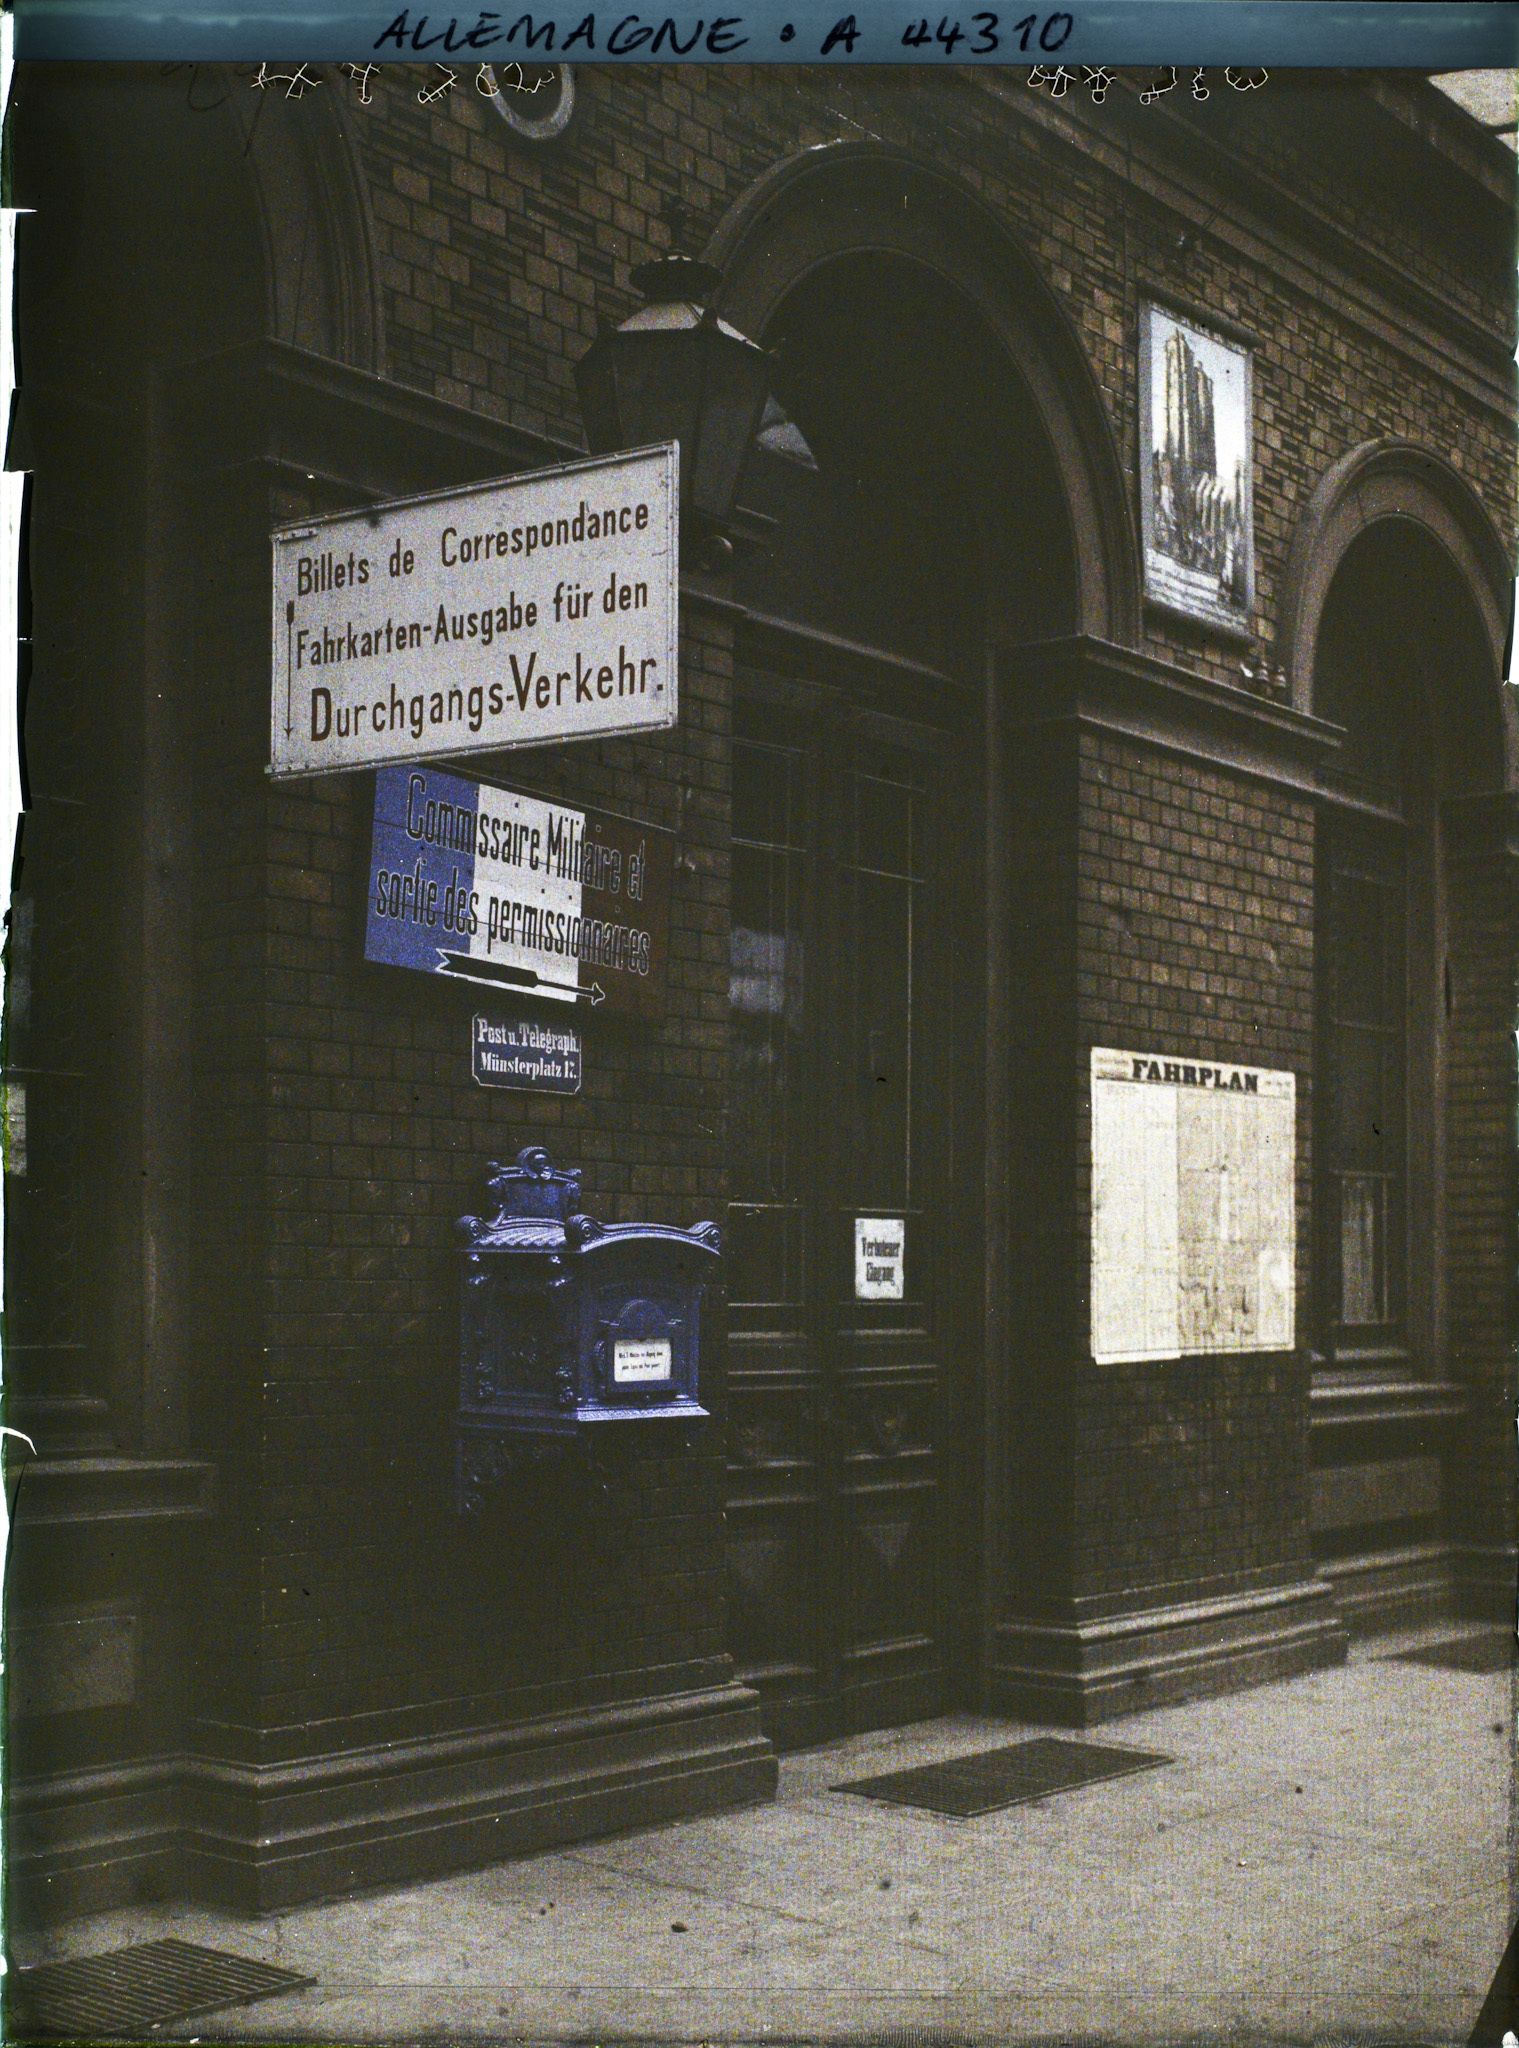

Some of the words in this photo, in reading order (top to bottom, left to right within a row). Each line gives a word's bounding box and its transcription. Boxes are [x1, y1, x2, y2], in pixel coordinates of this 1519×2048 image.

[821, 15, 861, 55] A
[297, 552, 370, 597] Billets
[388, 538, 415, 578] de
[441, 501, 649, 567] Correspondance
[297, 591, 538, 669] Fahrkarten-Ausgabe
[553, 582, 593, 622] für
[602, 573, 648, 614] den
[310, 646, 664, 742] Durchgangs-Verkehr.
[406, 773, 541, 871] Commissaire
[546, 812, 622, 893] Militaire
[627, 839, 646, 901] et
[376, 857, 438, 928] sortie
[443, 866, 479, 936] des
[487, 895, 650, 976] permissionnaires
[477, 1017, 507, 1045] Post
[508, 1031, 519, 1047] u.
[480, 1051, 562, 1081] Münsterplatz
[1131, 1058, 1259, 1094] FAHRPLAN
